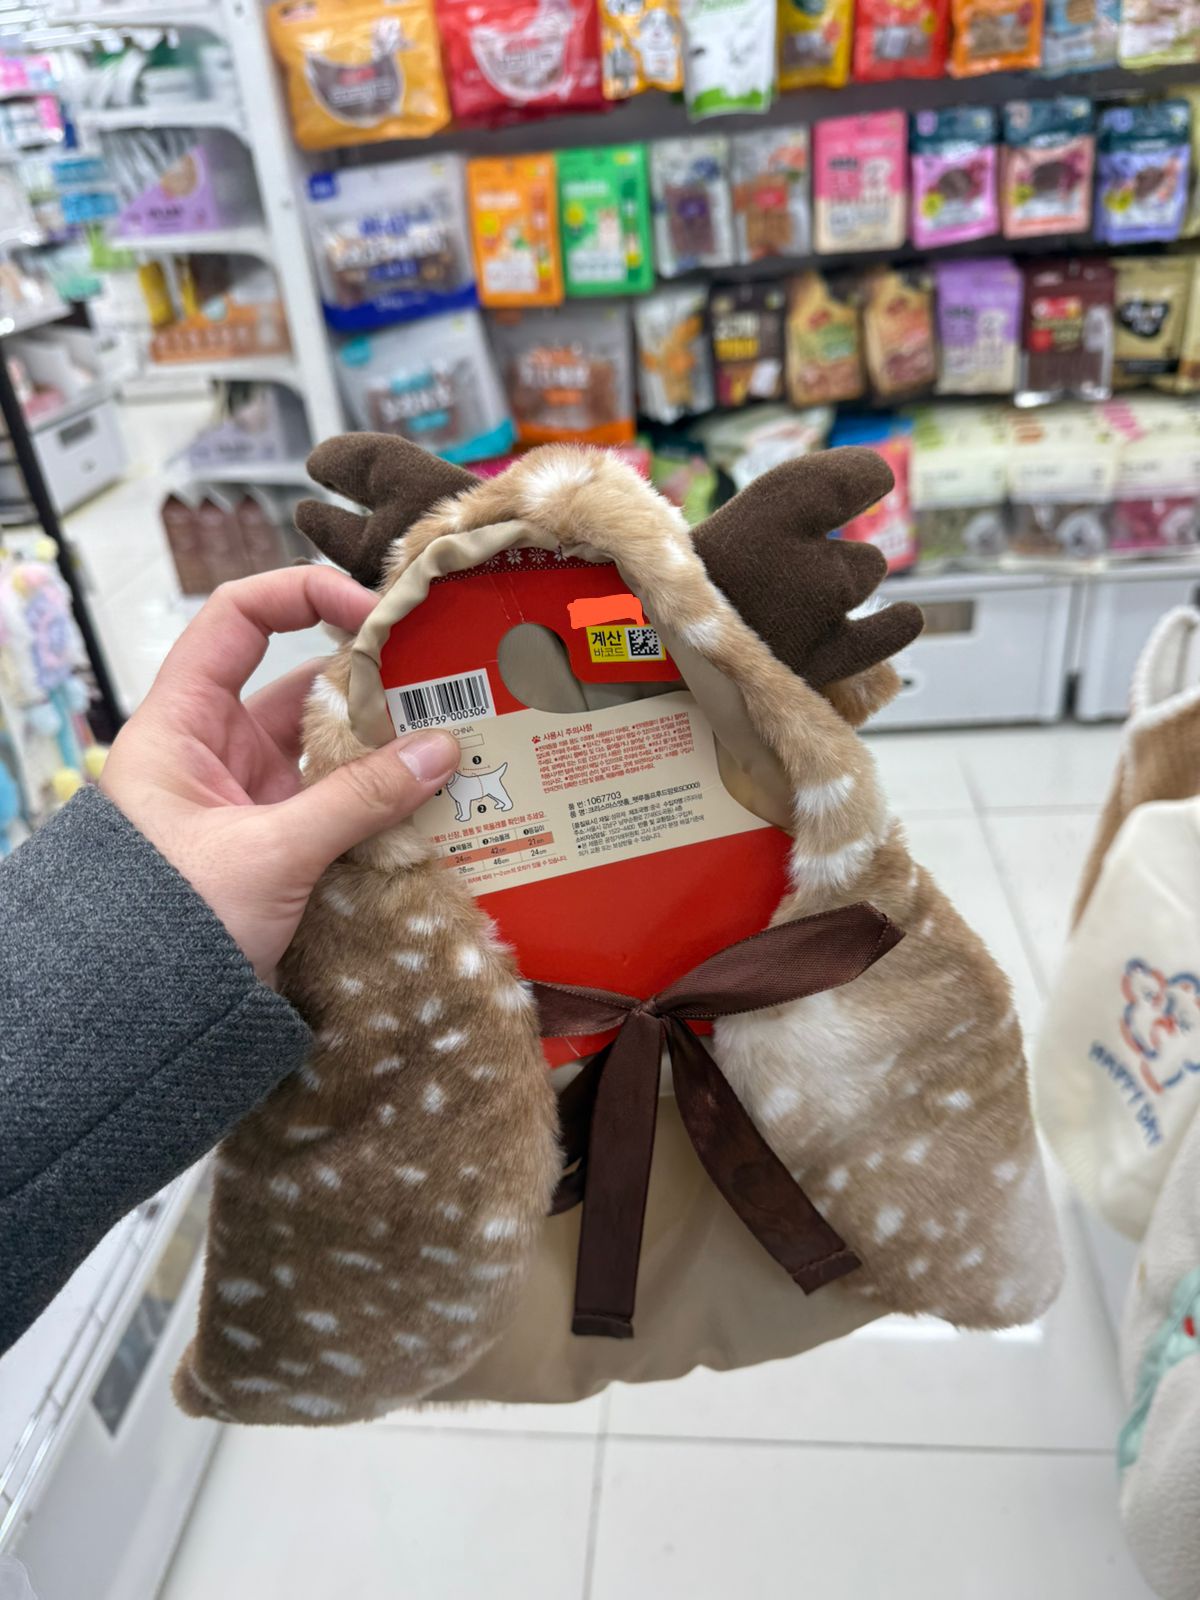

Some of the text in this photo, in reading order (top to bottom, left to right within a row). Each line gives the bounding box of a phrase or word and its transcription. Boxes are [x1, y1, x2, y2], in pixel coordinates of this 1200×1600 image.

[592, 631, 622, 647] 계산
[593, 647, 625, 658] 바코드
[399, 706, 486, 732] 8 808739 000306
[543, 724, 592, 740] 사용시 주의사항
